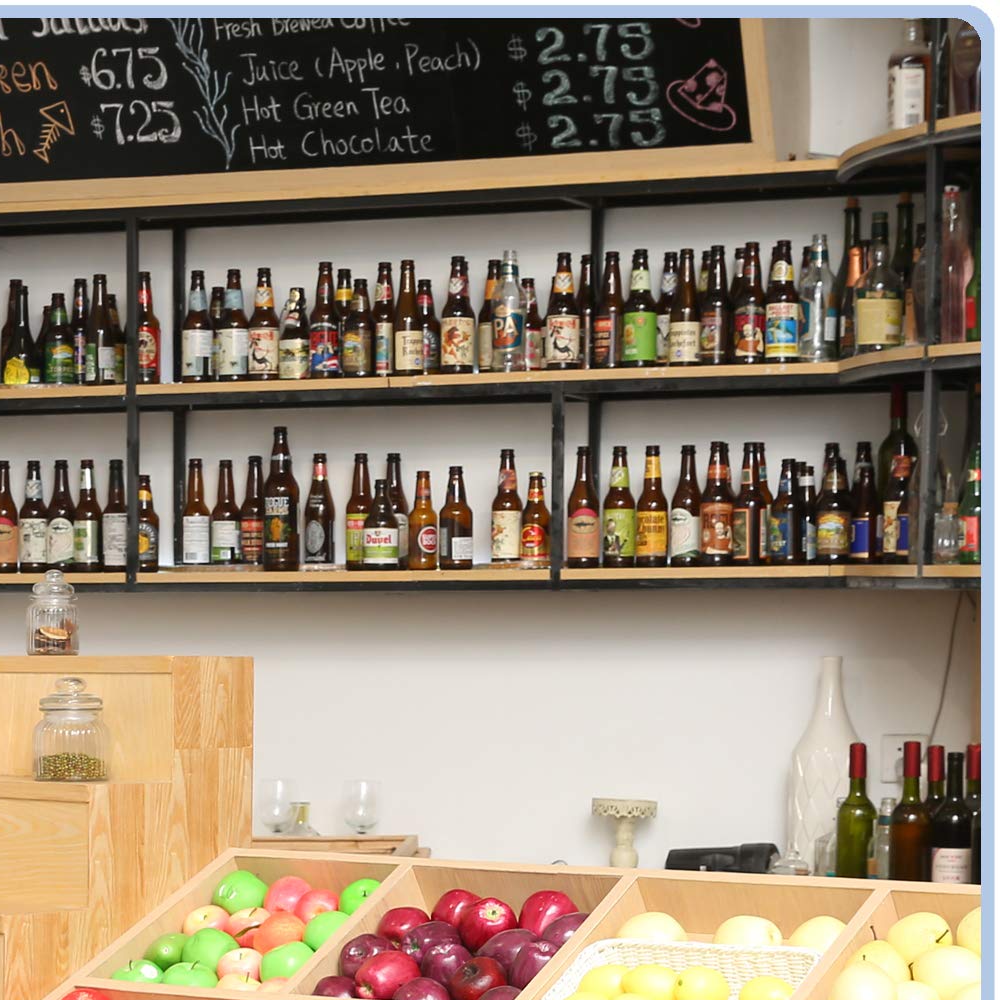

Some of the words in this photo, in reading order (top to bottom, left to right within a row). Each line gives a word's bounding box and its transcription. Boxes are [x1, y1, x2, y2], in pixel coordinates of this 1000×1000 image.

[213, 18, 262, 40] Fresh
[240, 53, 304, 86] Juice
[241, 95, 282, 126] Hot
[293, 92, 360, 121] Green
[360, 87, 411, 120] Tea
[249, 134, 287, 164] Hot
[301, 125, 433, 157] Chocolate
[366, 534, 392, 545] Duvel
